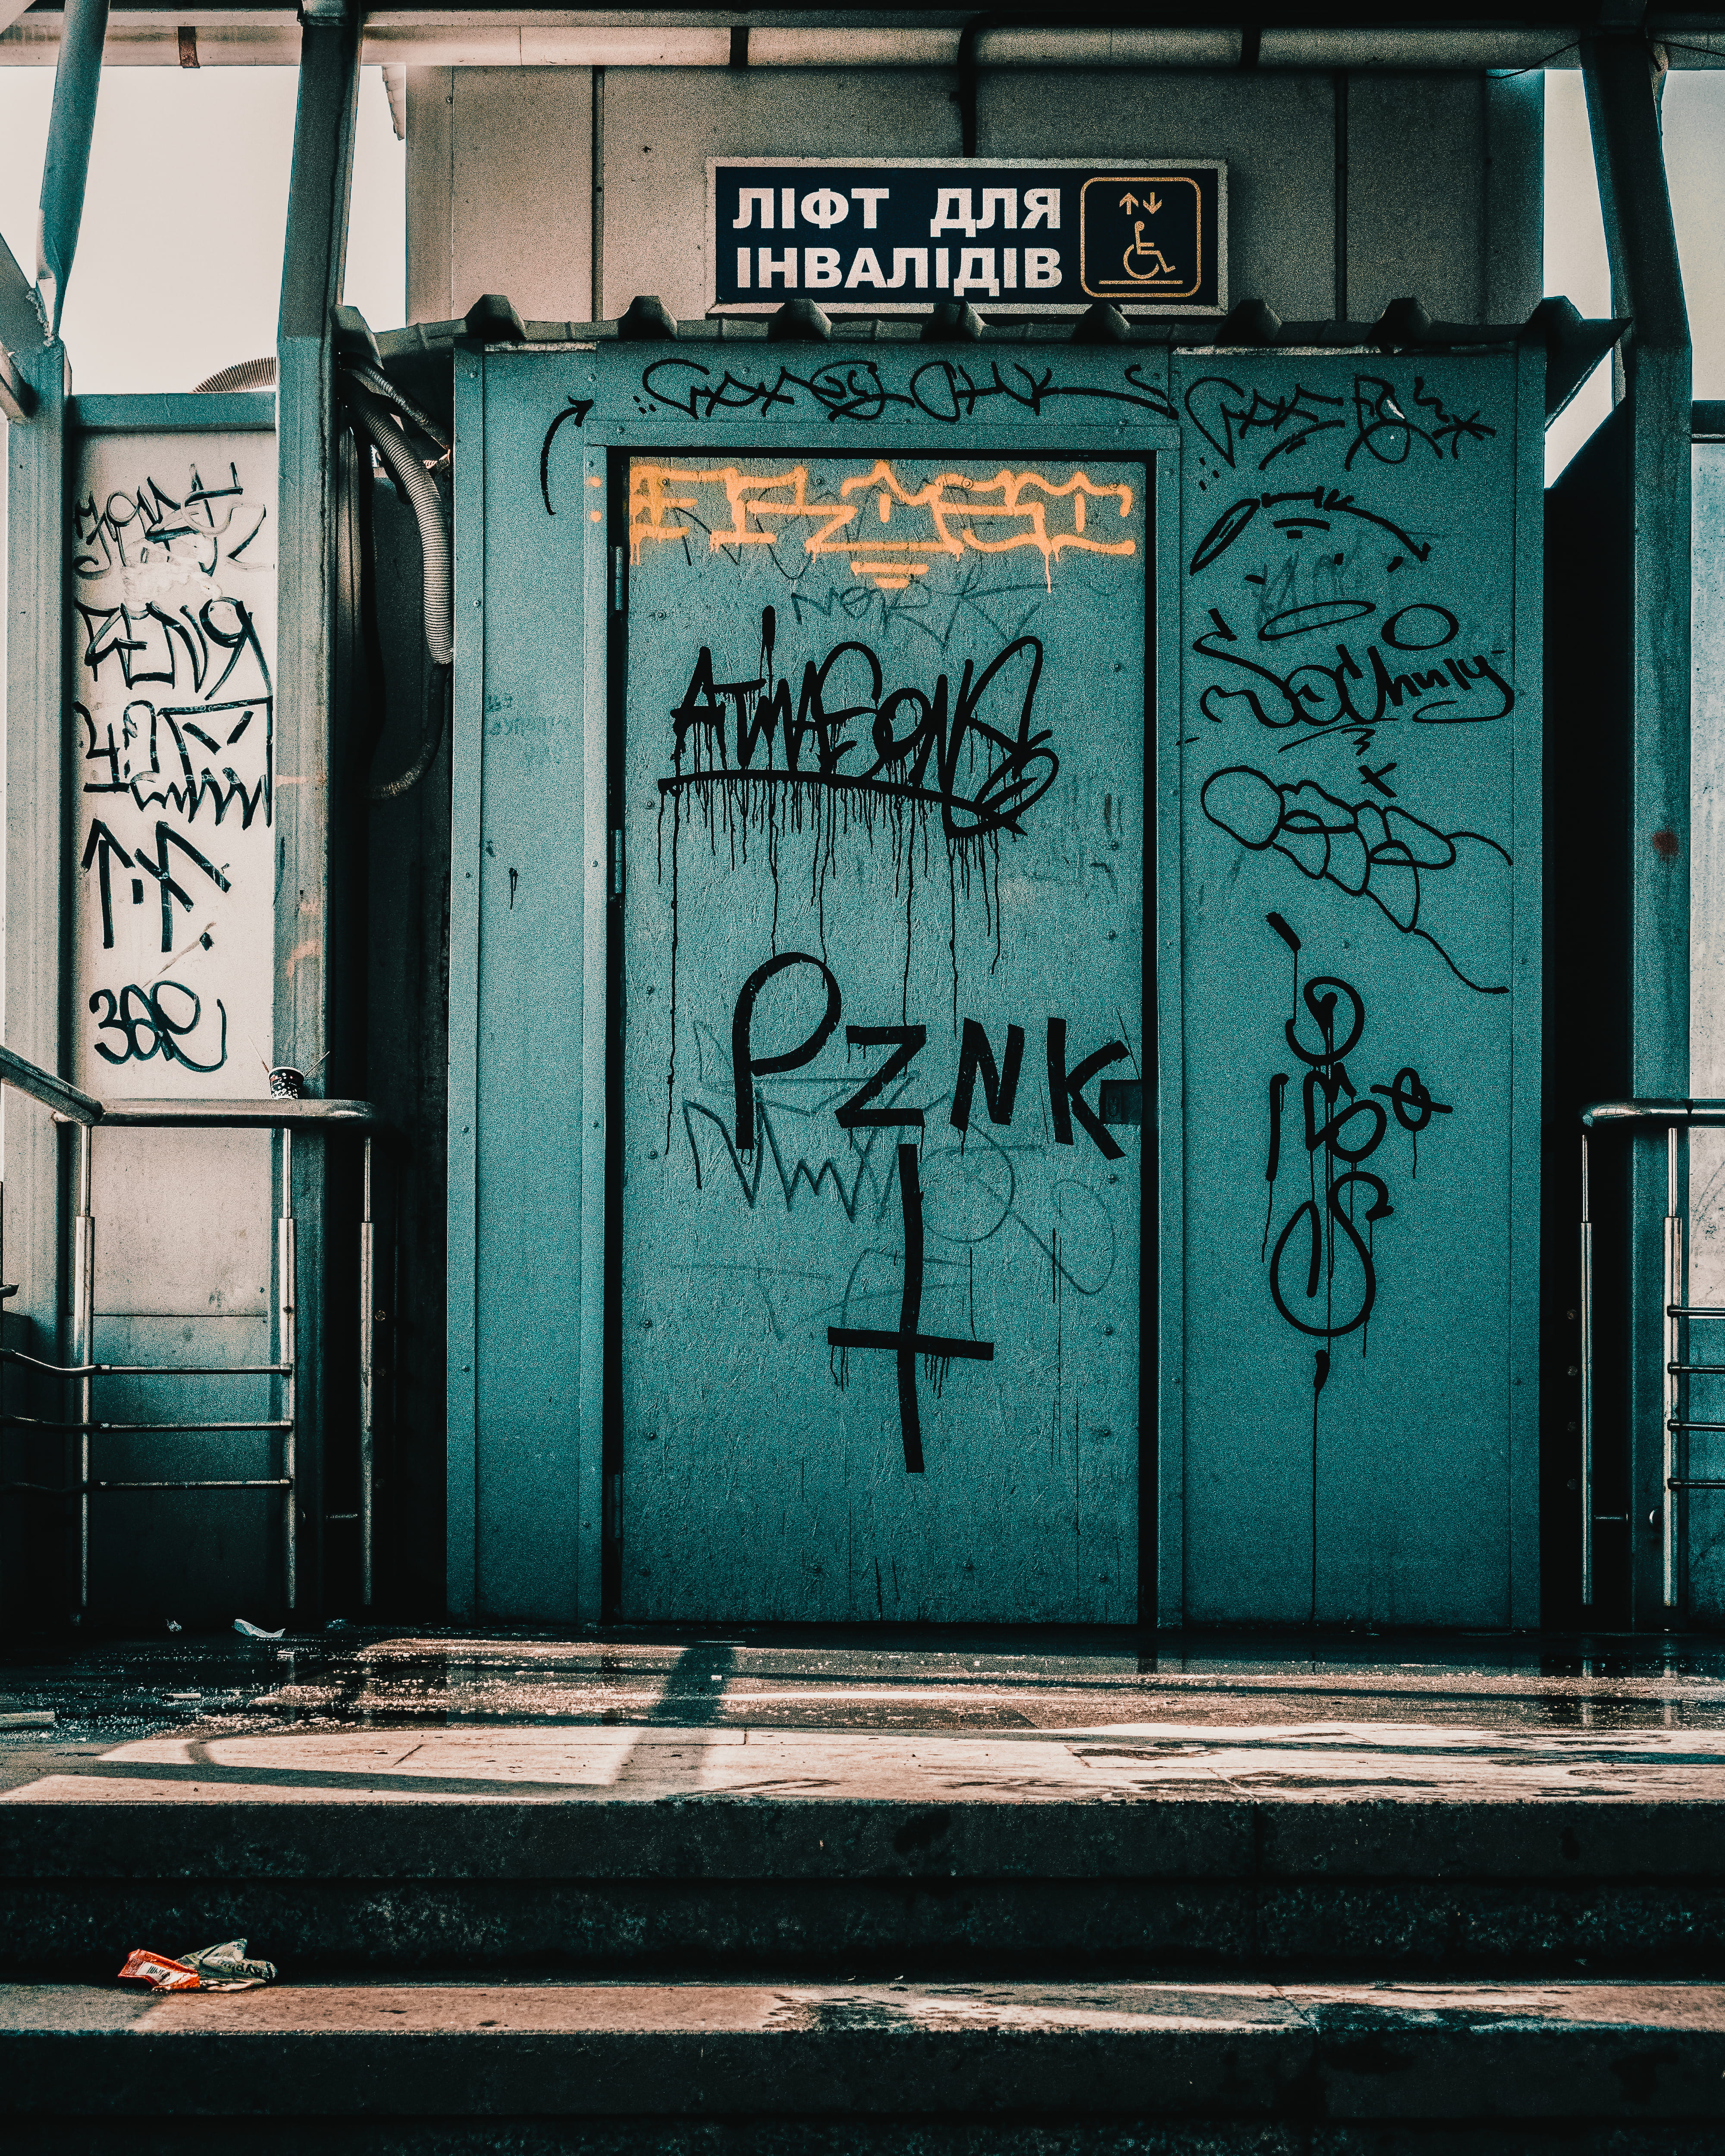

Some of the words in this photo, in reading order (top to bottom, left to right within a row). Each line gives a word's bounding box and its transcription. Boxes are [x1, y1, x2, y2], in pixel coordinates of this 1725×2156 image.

[733, 188, 889, 229] ЛІФТ
[930, 188, 1061, 237] ДЛЯ
[737, 247, 1062, 297] ІНВАЛІДІВ
[732, 951, 1131, 1161] PZNK
